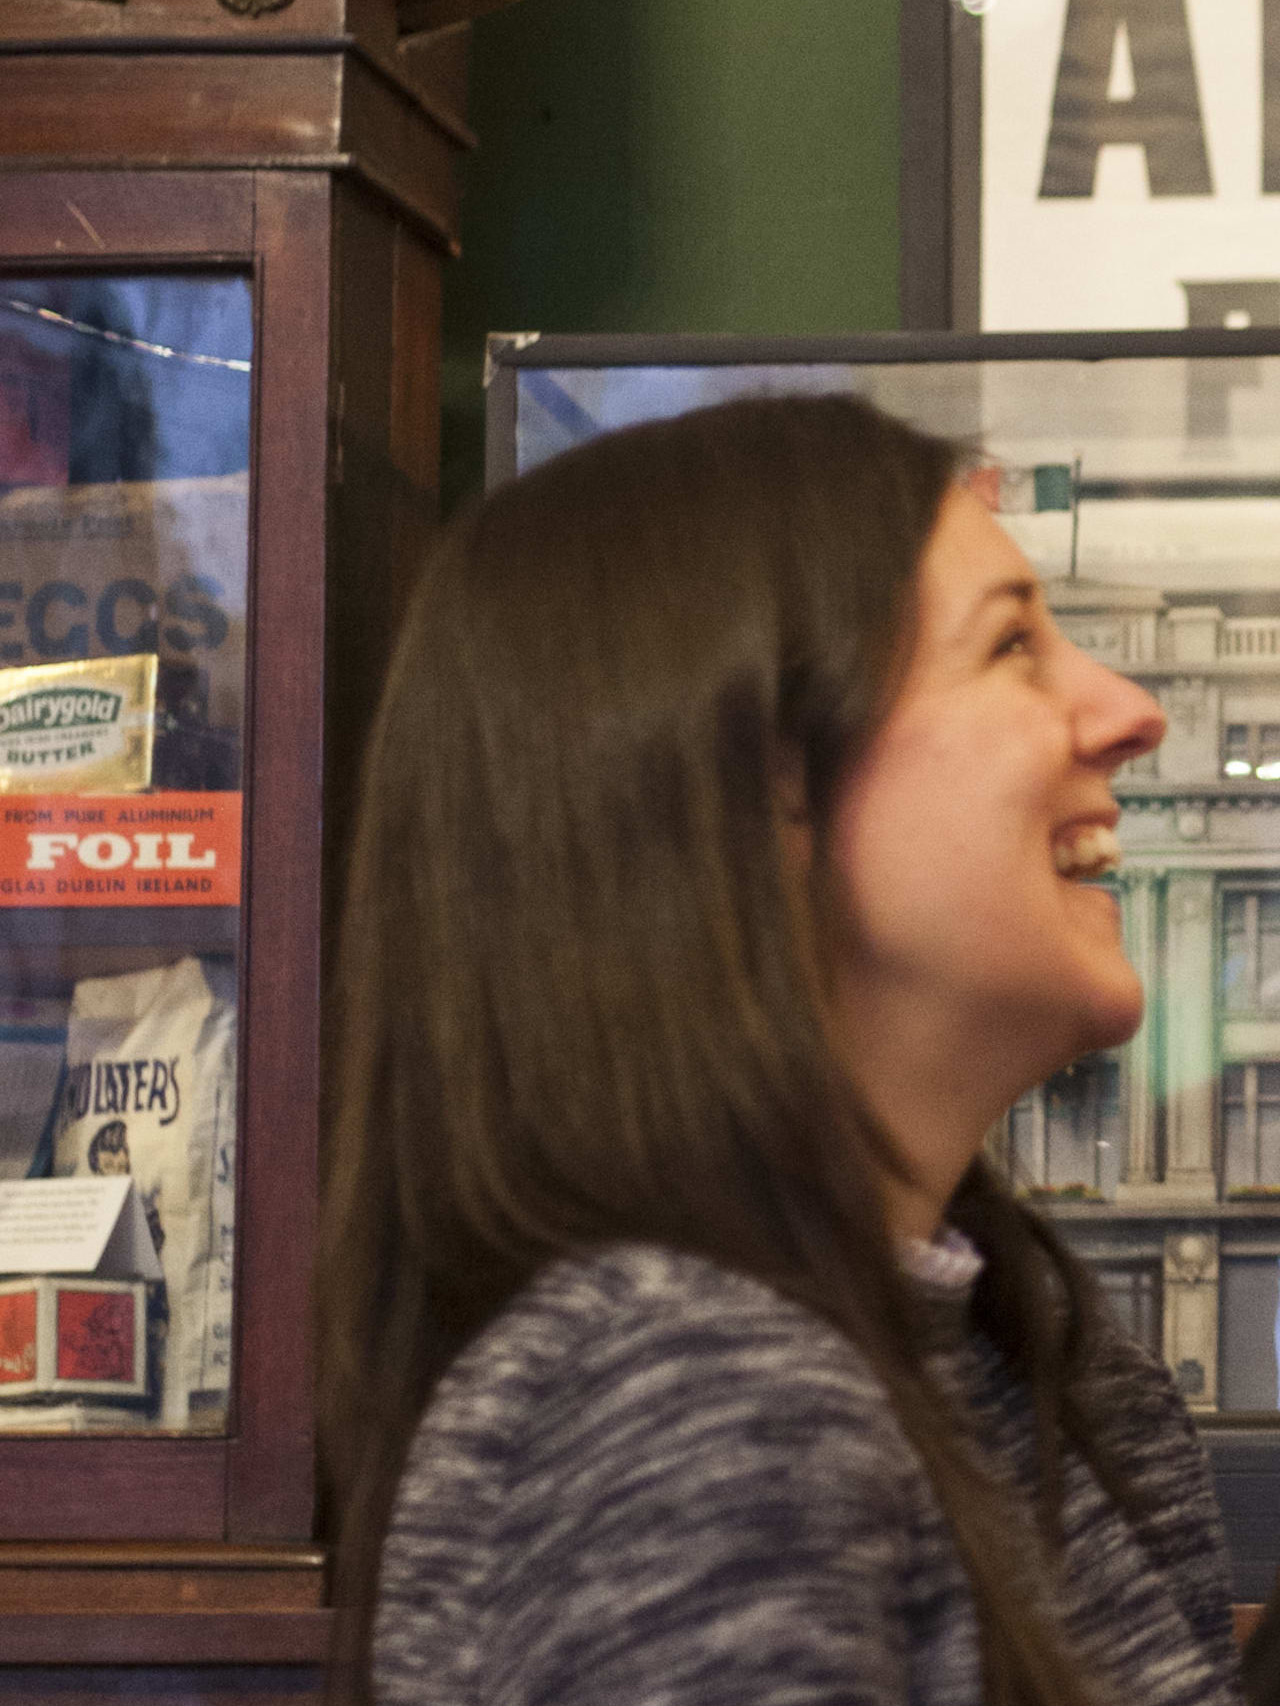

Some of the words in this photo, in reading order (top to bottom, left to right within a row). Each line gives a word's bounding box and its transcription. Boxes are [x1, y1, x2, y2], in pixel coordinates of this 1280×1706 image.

[8, 741, 96, 766] BUTTER
[5, 809, 53, 825] FROM
[64, 808, 106, 824] PURE
[117, 806, 215, 824] ALUMINIUM
[26, 832, 217, 871] FOIL
[56, 876, 126, 894] DUBLIN
[137, 876, 213, 893] IRELAND
